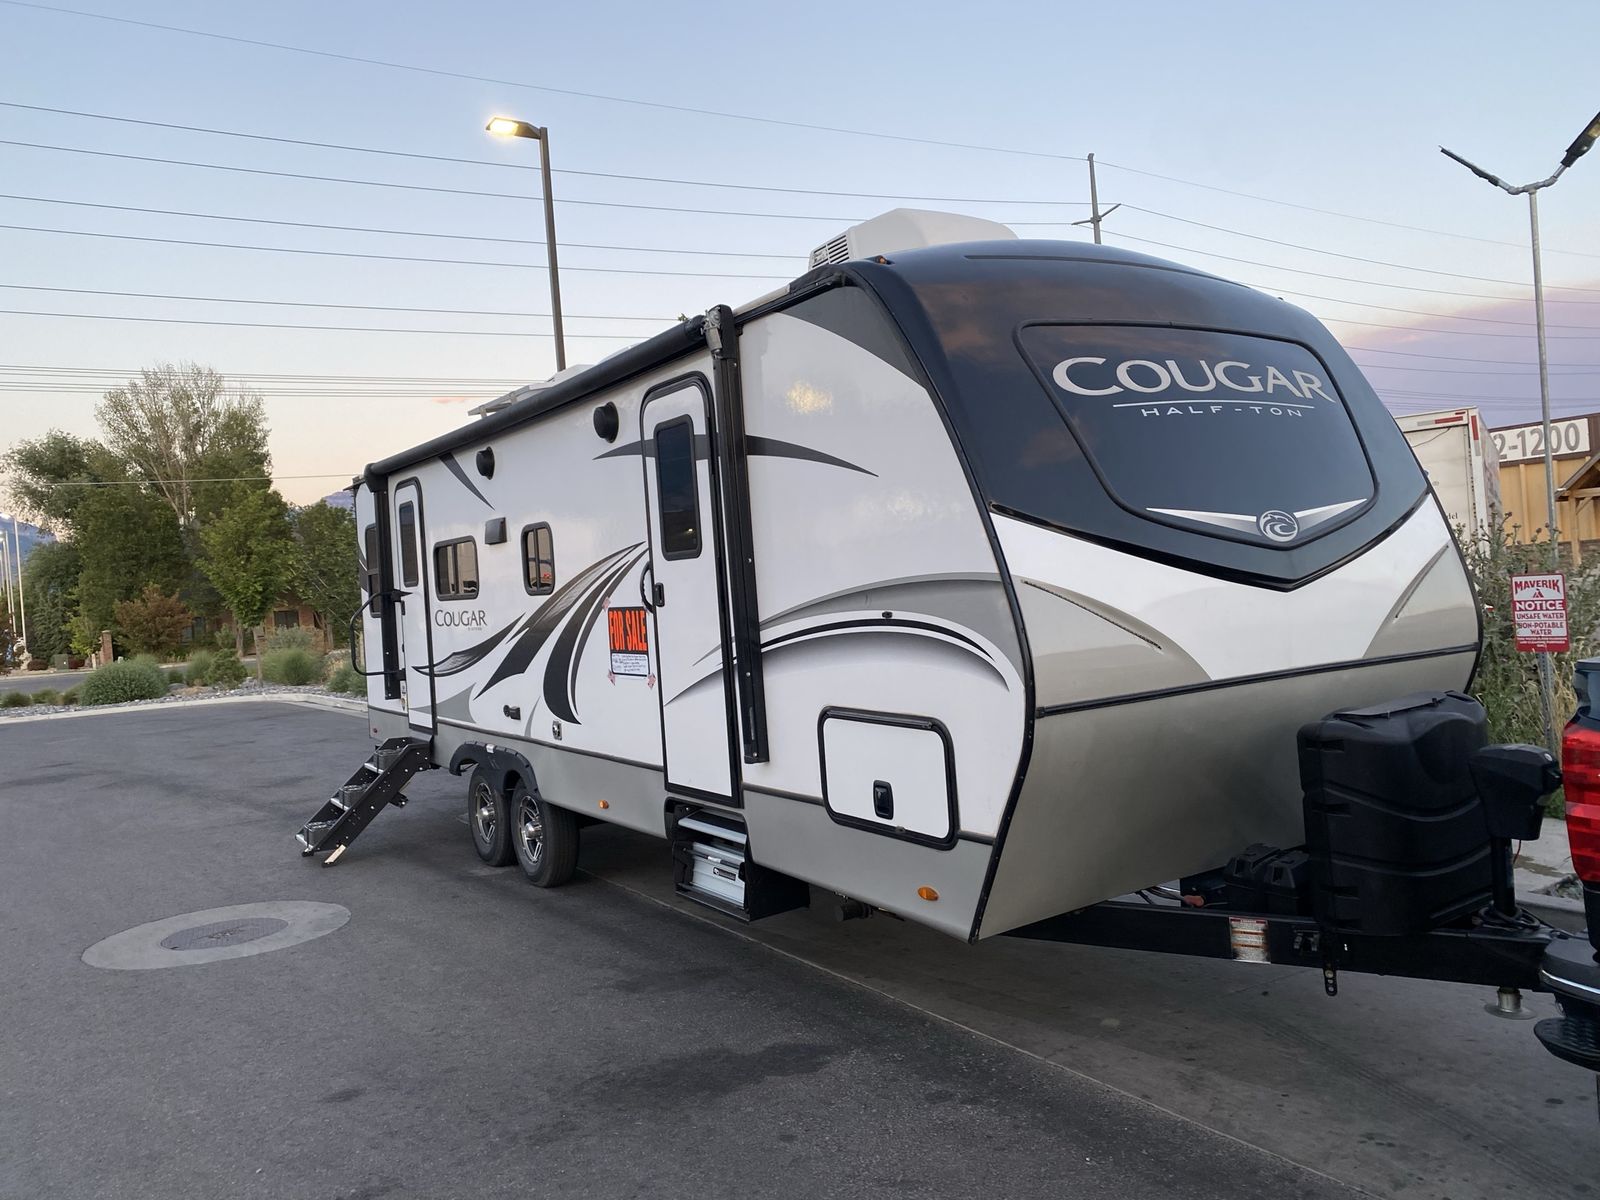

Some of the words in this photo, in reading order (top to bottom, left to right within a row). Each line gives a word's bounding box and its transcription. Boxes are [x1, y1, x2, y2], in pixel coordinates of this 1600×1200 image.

[1053, 357, 1336, 403] COUGAR
[1514, 579, 1560, 594] MAVERIK
[1516, 601, 1563, 611] NOTICE
[435, 610, 487, 626] COUGAR
[609, 610, 625, 650] FOR
[626, 610, 647, 650] SALE
